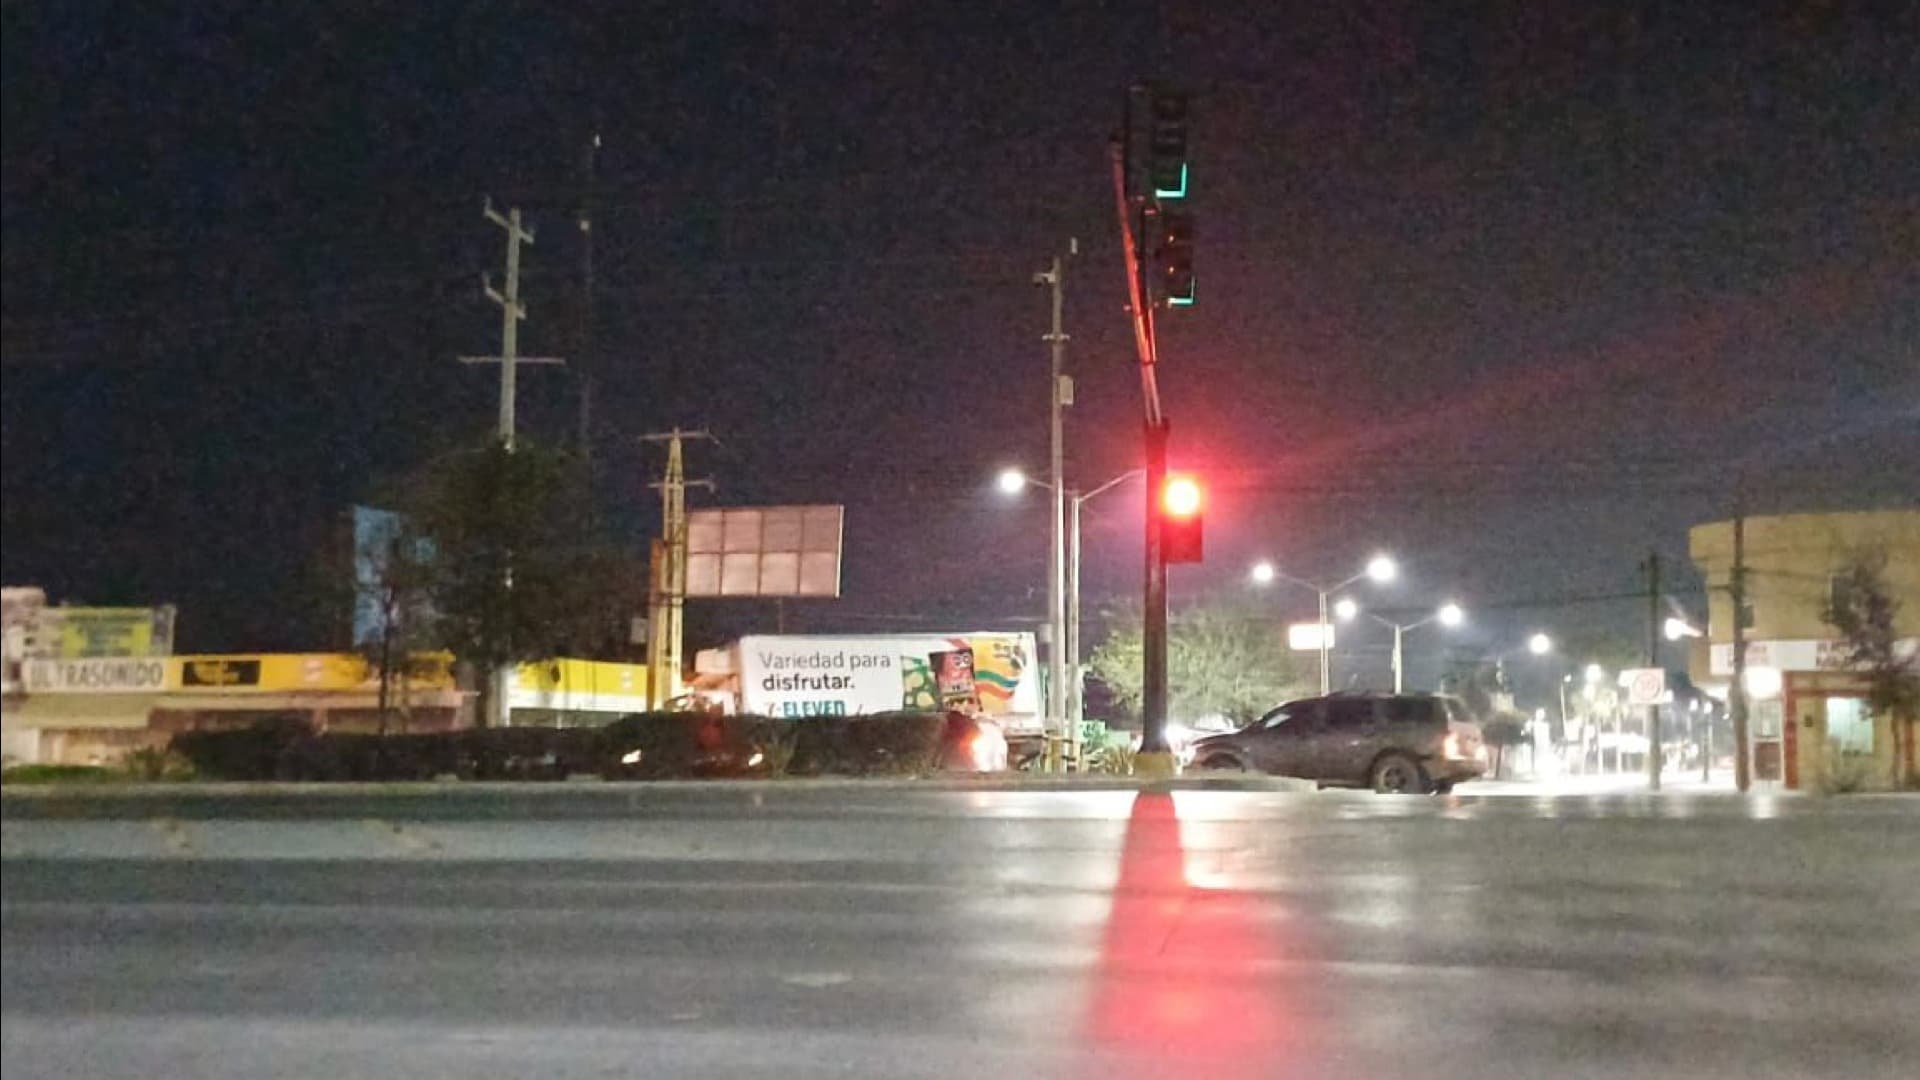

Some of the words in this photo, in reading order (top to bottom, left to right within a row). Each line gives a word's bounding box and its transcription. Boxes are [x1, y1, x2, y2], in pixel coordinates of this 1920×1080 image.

[759, 651, 844, 669] Variedad
[851, 654, 891, 671] para
[762, 673, 855, 691] disfrutar.
